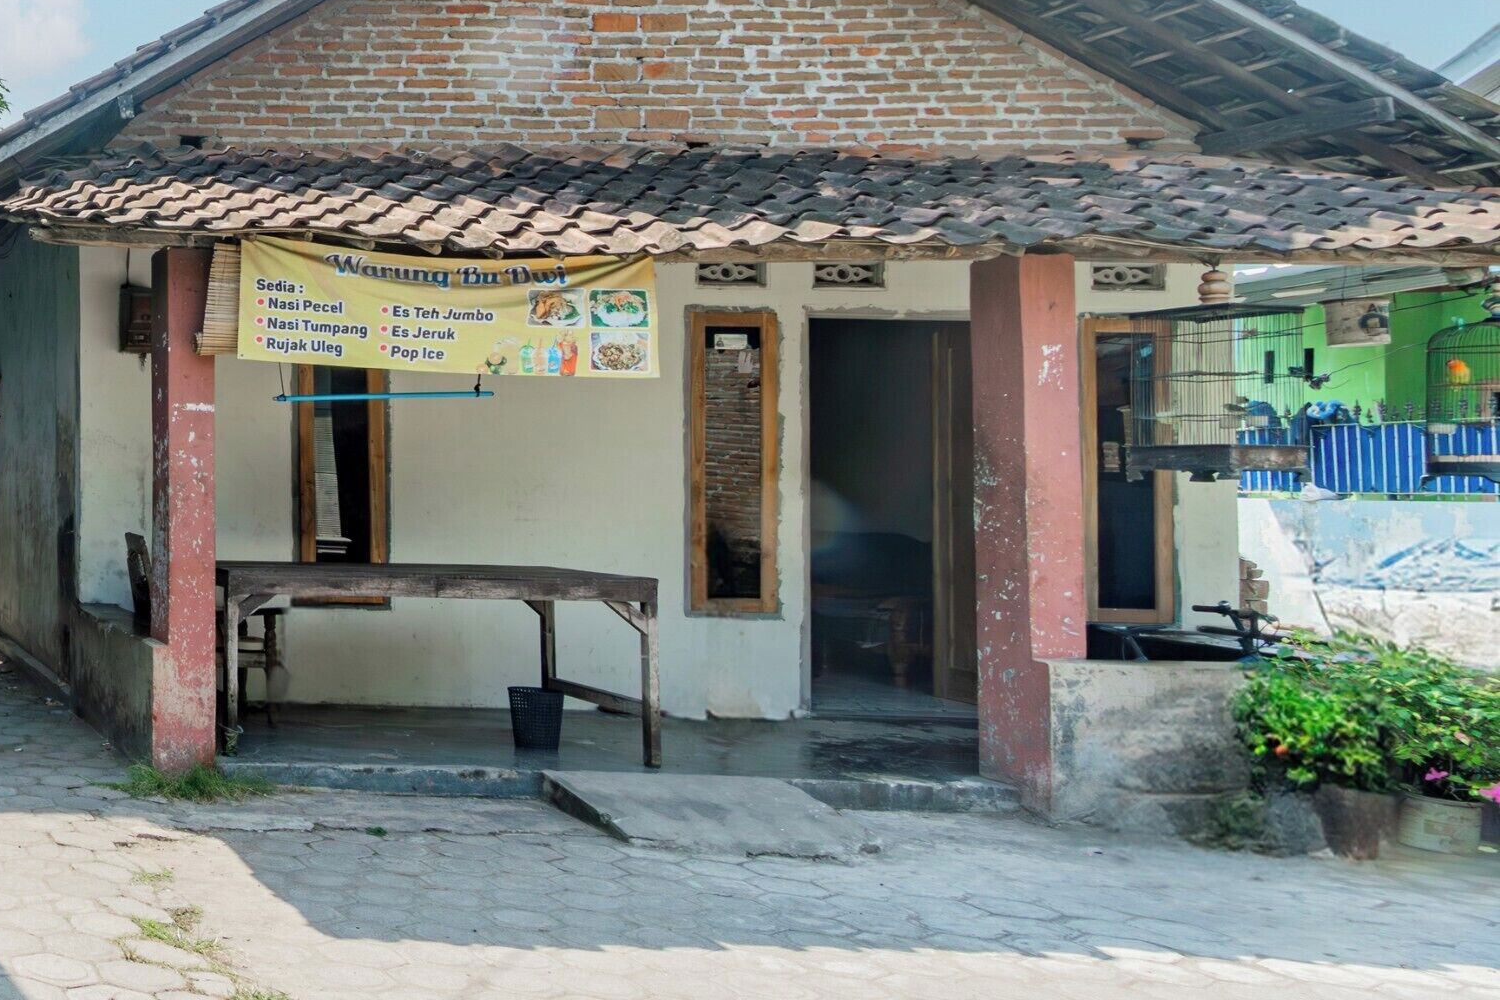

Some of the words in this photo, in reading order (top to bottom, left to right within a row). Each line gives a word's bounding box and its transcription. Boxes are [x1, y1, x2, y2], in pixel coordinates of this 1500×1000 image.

[326, 254, 449, 287] Warung
[456, 267, 501, 285] Bu
[504, 266, 567, 285] Dwi
[256, 279, 295, 293] Sedia
[268, 297, 300, 311] Nasi
[303, 300, 343, 314] Pecel
[392, 305, 410, 318] Es
[414, 306, 439, 320] Teh
[442, 308, 494, 322] Jumbo
[267, 317, 299, 330] Nasi
[302, 319, 368, 339] Tumpang
[391, 325, 409, 338] Es
[412, 326, 455, 341] Jeruk
[266, 337, 307, 354] Rujak
[311, 340, 343, 357] Uleg
[390, 345, 419, 362] Pop
[422, 347, 445, 360] Ice
